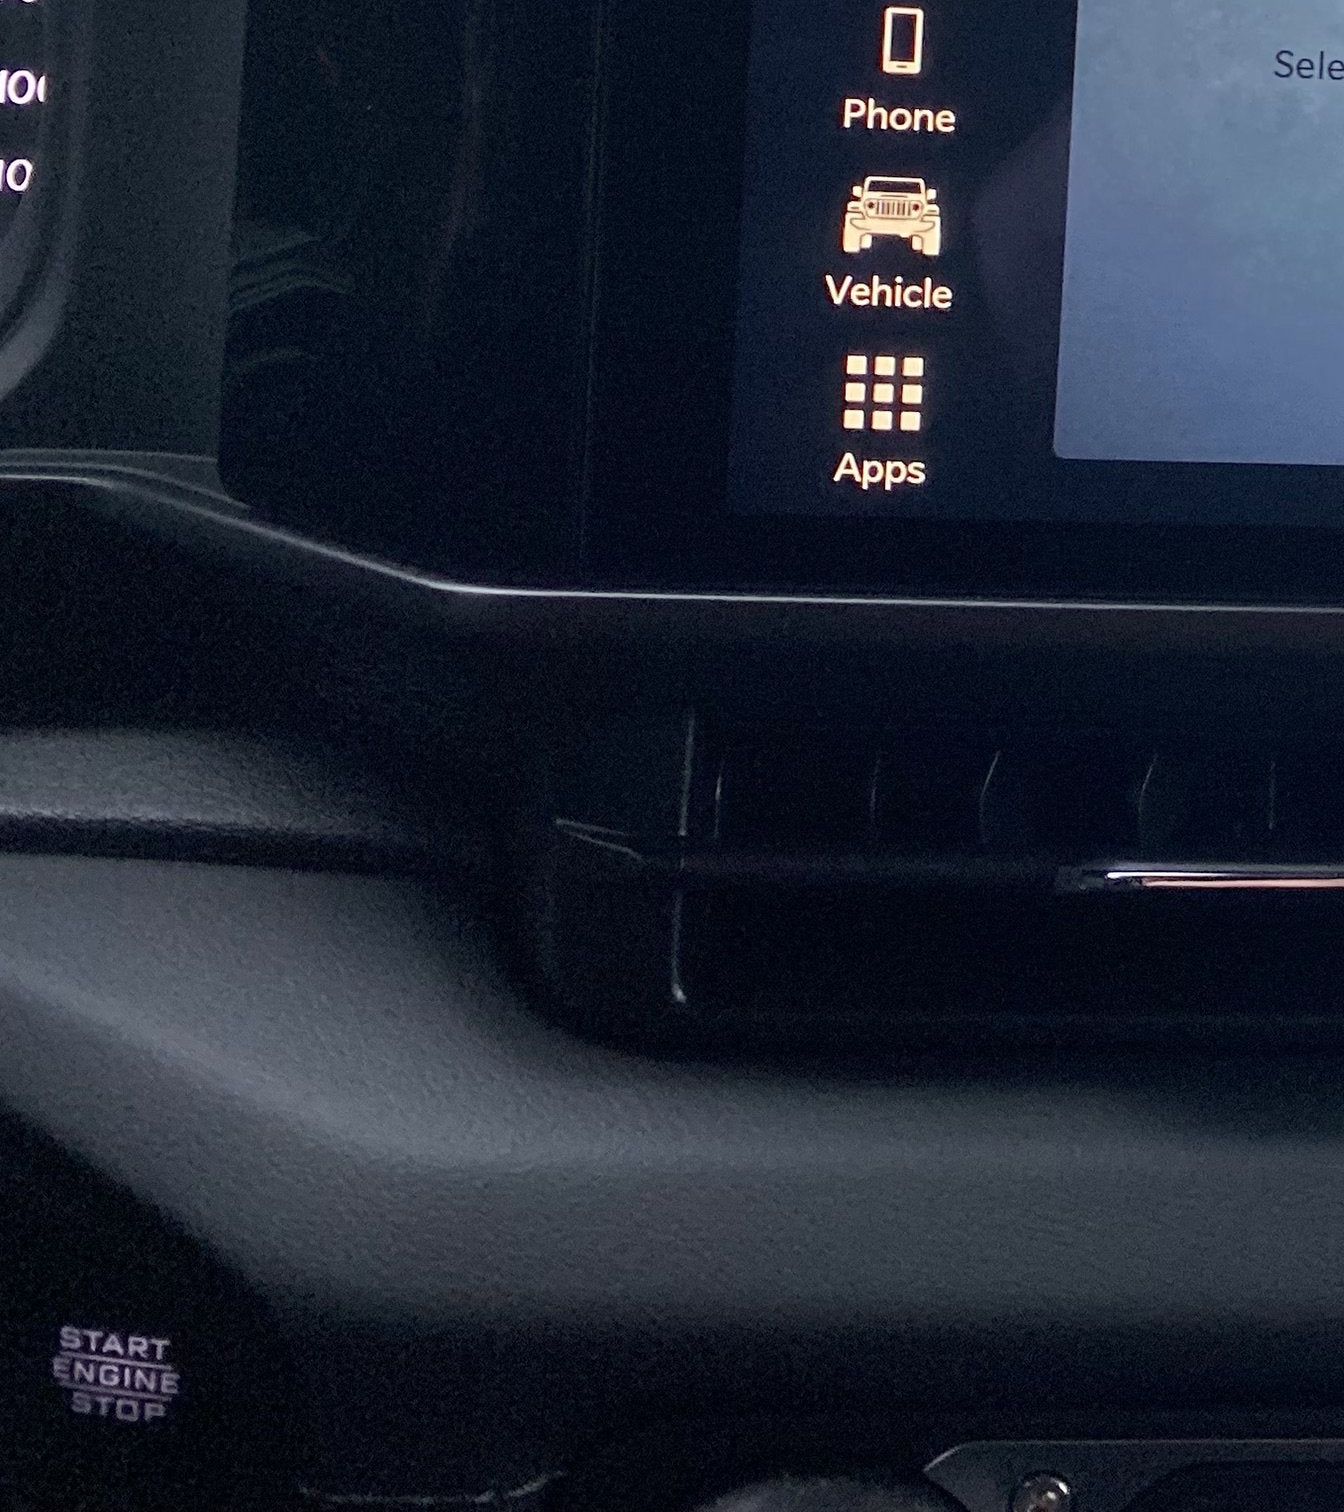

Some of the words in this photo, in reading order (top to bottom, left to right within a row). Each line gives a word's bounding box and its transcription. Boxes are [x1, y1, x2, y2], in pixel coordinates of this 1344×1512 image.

[843, 97, 956, 133] Phone
[825, 274, 953, 309] Vehicle
[833, 452, 927, 491] Apps
[59, 1325, 171, 1360] START
[52, 1356, 181, 1395] ENGINE
[71, 1391, 166, 1422] STOP
